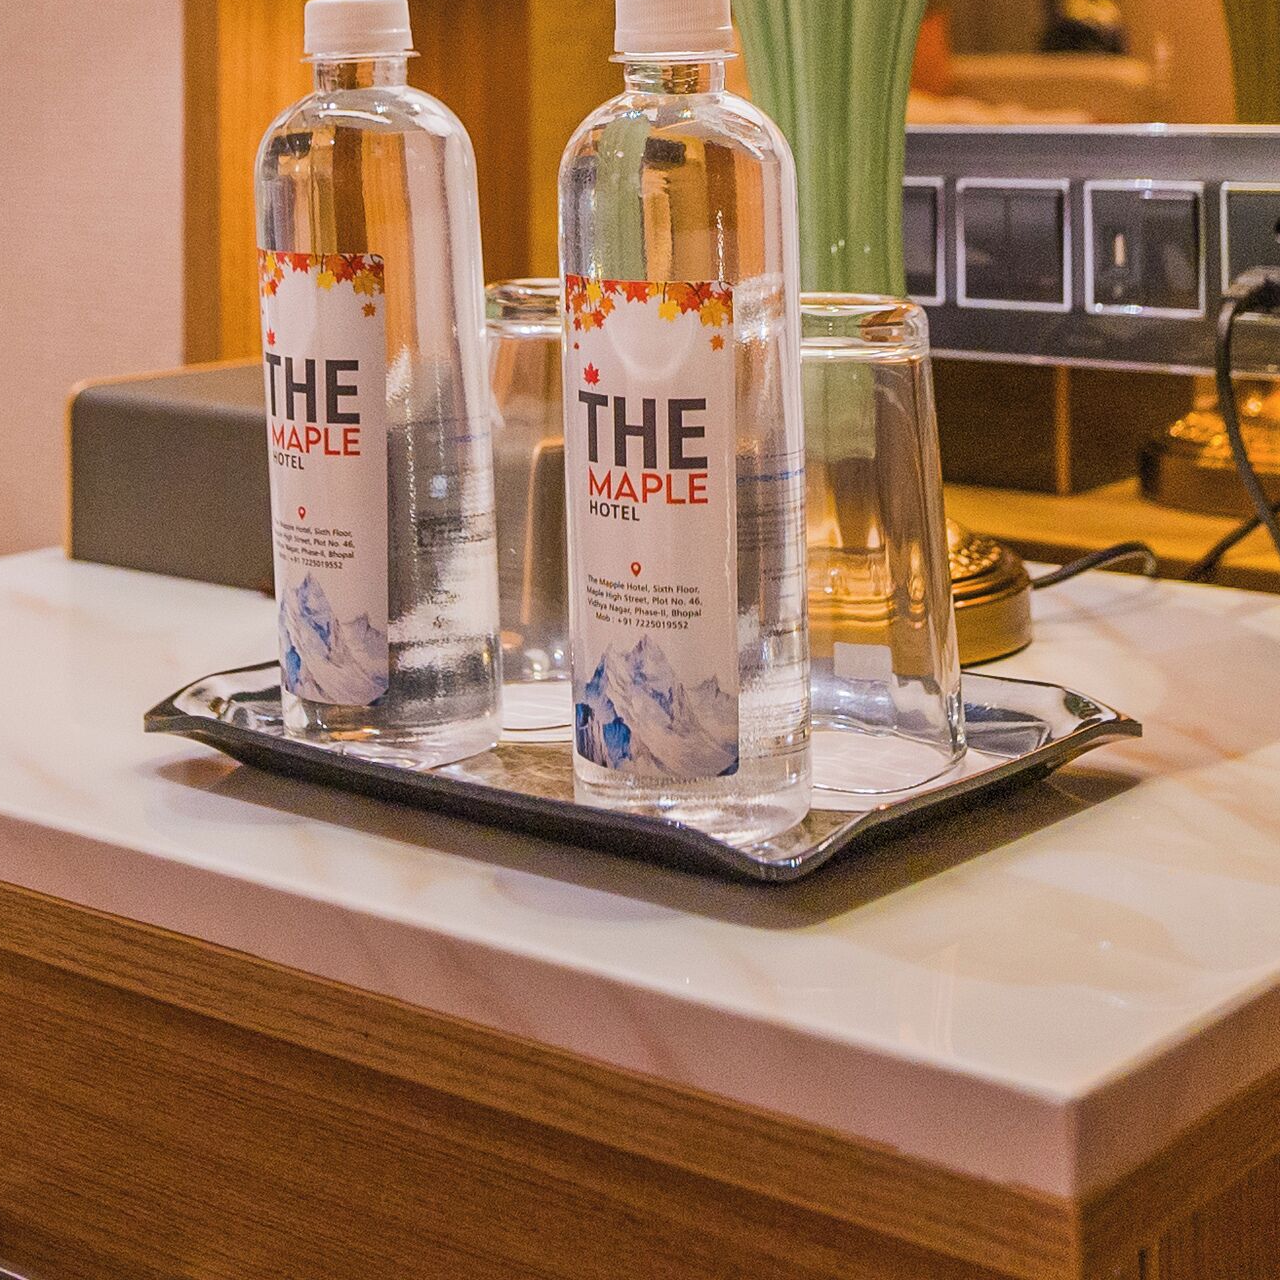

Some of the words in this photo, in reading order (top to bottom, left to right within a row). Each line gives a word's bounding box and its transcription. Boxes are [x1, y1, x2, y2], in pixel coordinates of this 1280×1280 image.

[266, 352, 360, 424] THE
[272, 422, 361, 456] MAPLE
[578, 389, 708, 470] THE
[273, 452, 305, 470] HOTEL
[588, 465, 709, 505] MAPLE
[589, 499, 640, 522] HOTEL
[329, 550, 354, 560] Bhopal
[588, 574, 598, 585] The
[626, 583, 650, 593] Hotel,
[653, 584, 674, 593] Sixth
[676, 585, 700, 594] Floor,
[605, 591, 622, 602] High
[623, 594, 650, 605] Street,
[652, 596, 668, 605] Plot
[671, 598, 686, 606] No.
[608, 602, 632, 616] Nagar,
[671, 608, 702, 620] Bhopal
[635, 619, 689, 630] 7225019552
